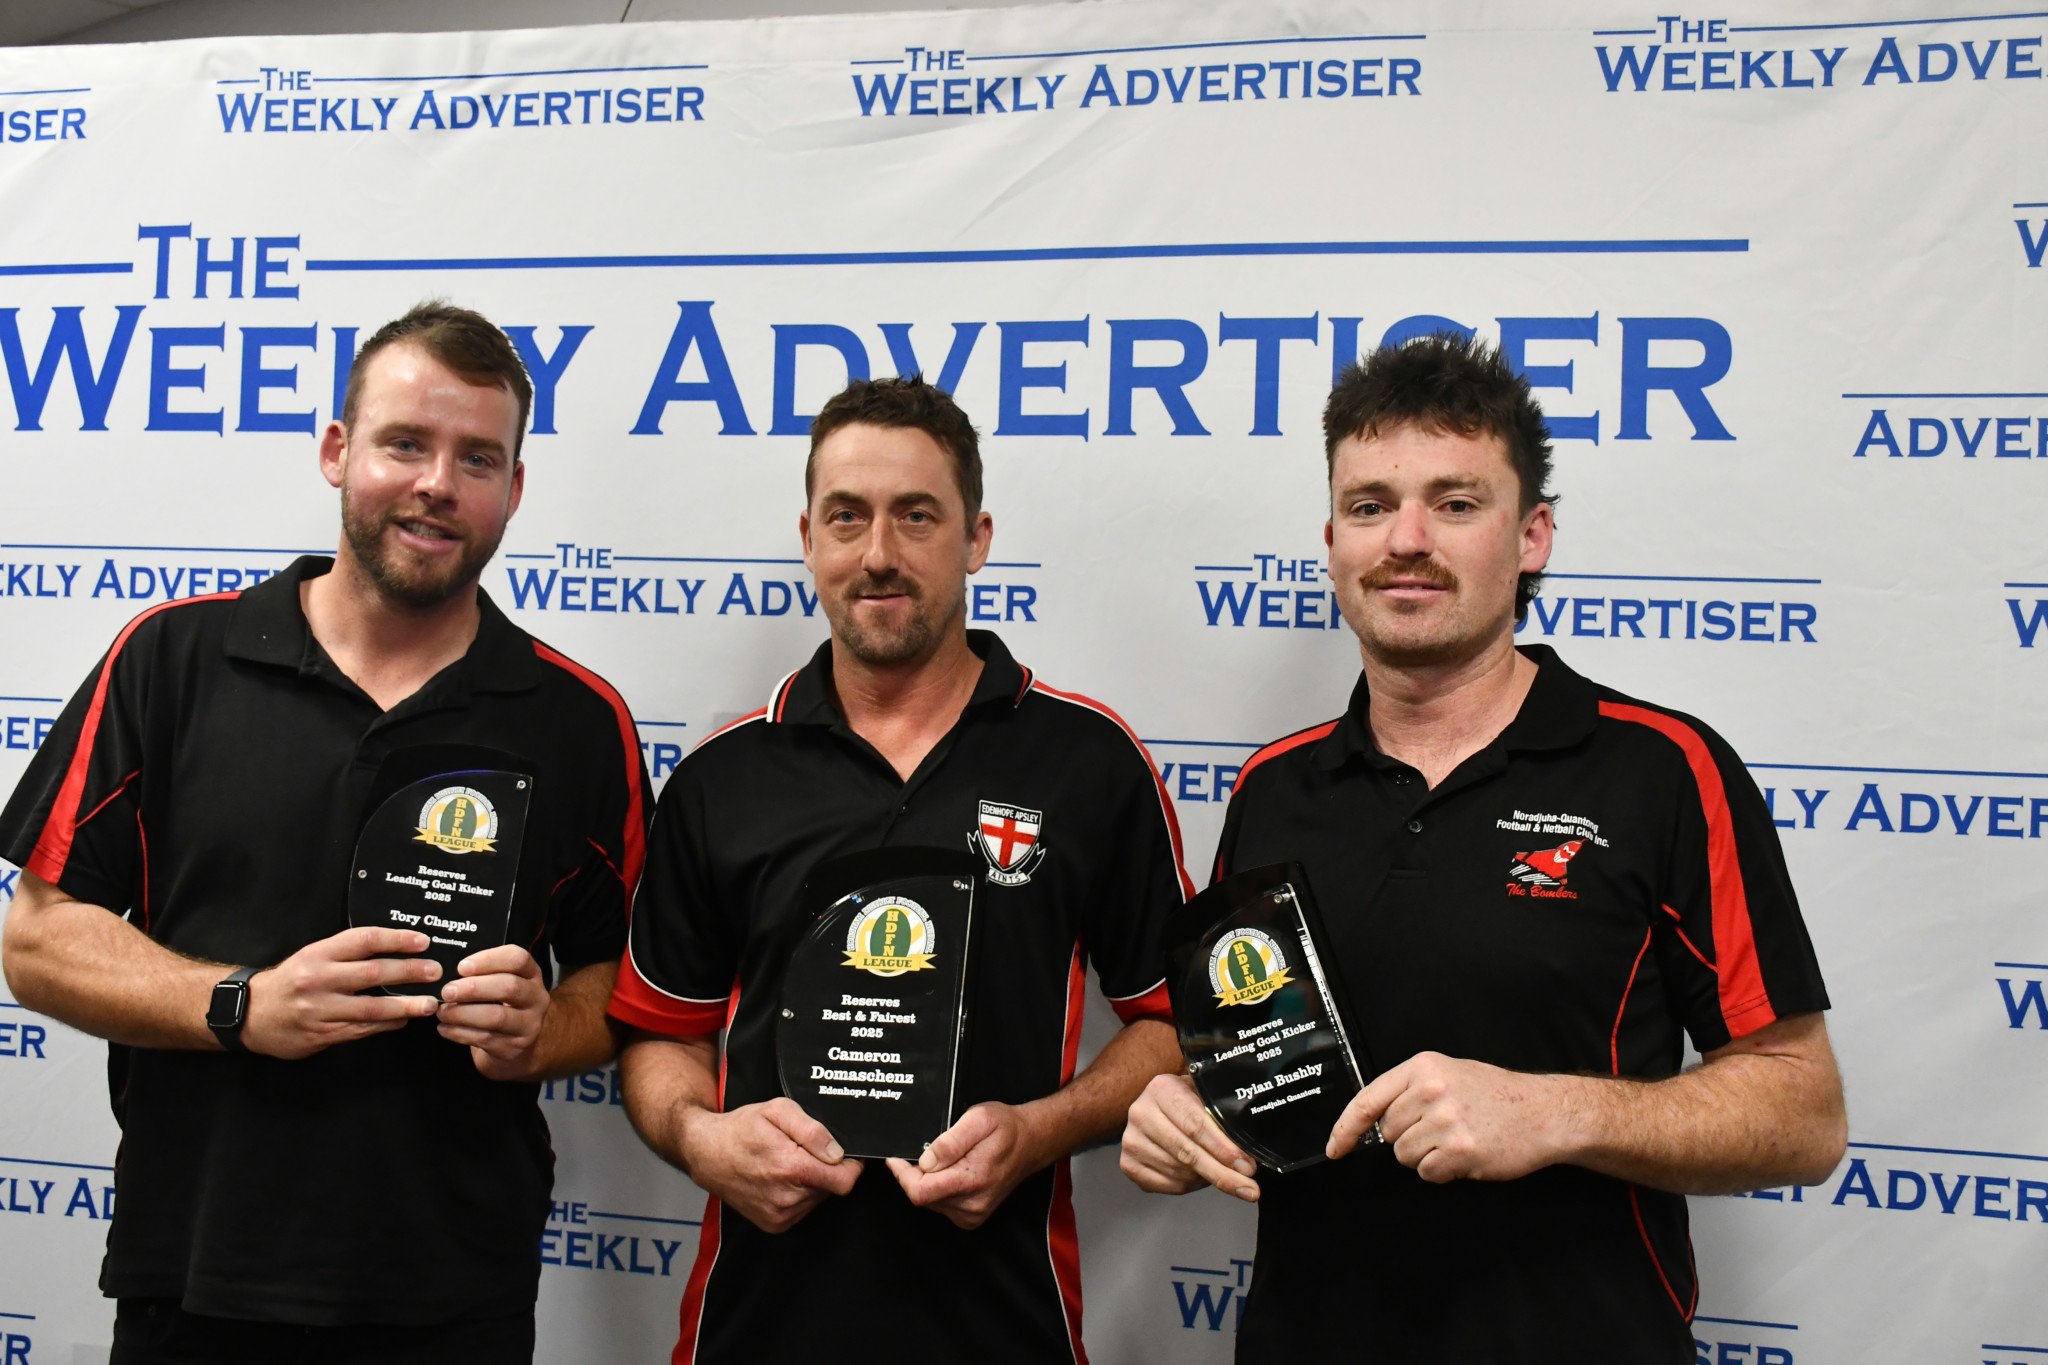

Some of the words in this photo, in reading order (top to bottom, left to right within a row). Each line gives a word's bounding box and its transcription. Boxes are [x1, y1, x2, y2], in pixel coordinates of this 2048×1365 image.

[1657, 15, 1729, 44] THE
[904, 46, 966, 72] THE
[1593, 44, 1849, 93] WEEKLY
[1861, 35, 2048, 87] ADVE
[259, 67, 312, 92] THE
[851, 72, 1068, 118] WEEKLY
[1079, 57, 1423, 109] ADVERTISER
[217, 91, 399, 135] WEEKLY
[409, 85, 706, 131] ADVERTISER
[137, 222, 301, 301] THE
[0, 304, 595, 437] WEEY
[555, 543, 613, 570] THE
[1253, 553, 1320, 583] THE
[506, 566, 707, 615] WEEKLY
[982, 804, 1014, 818] EDENHOPE
[1015, 811, 1038, 823] APSLEY
[1513, 810, 1598, 834] Noradjuha-Quantong
[433, 835, 477, 849] LEAGUE
[1497, 820, 1531, 832] Football
[1533, 823, 1540, 832] &
[1543, 824, 1574, 835] Netball
[1576, 827, 1594, 841] Club
[1595, 835, 1610, 848] Inc.
[385, 872, 430, 888] Leading
[431, 880, 456, 891] Goal
[458, 884, 494, 896] Kicker
[418, 865, 466, 880] Reserves
[424, 891, 451, 902] 2025
[1505, 883, 1526, 896] The
[1530, 886, 1578, 899] Bombers
[390, 909, 420, 926] Tory
[423, 915, 477, 932] Chapple
[432, 936, 468, 948] Quantong
[863, 958, 912, 968] LEAGUE
[841, 994, 900, 1007] Reserves
[1233, 980, 1275, 1001] LEAGUE
[822, 1009, 851, 1021] Best
[855, 1010, 866, 1021] &
[869, 1011, 916, 1024] Fairest
[851, 1027, 883, 1038] 2025
[1214, 1042, 1255, 1062] Leading
[1256, 1032, 1281, 1047] Goal
[1281, 1020, 1316, 1038] Kicker
[1237, 1018, 1284, 1040] Reserves
[828, 1047, 901, 1063] Cameron
[1256, 1046, 1282, 1062] 2025
[810, 1065, 914, 1084] Domaschenz
[1235, 1081, 1274, 1100] Dylan
[1274, 1063, 1322, 1087] Bushby
[819, 1086, 867, 1098] Edenhope
[868, 1088, 902, 1100] Apsley
[1250, 1100, 1286, 1114] Noradjuha
[1286, 1086, 1321, 1102] Quantong
[549, 1200, 589, 1225] HE
[539, 1227, 683, 1277] EEKLY
